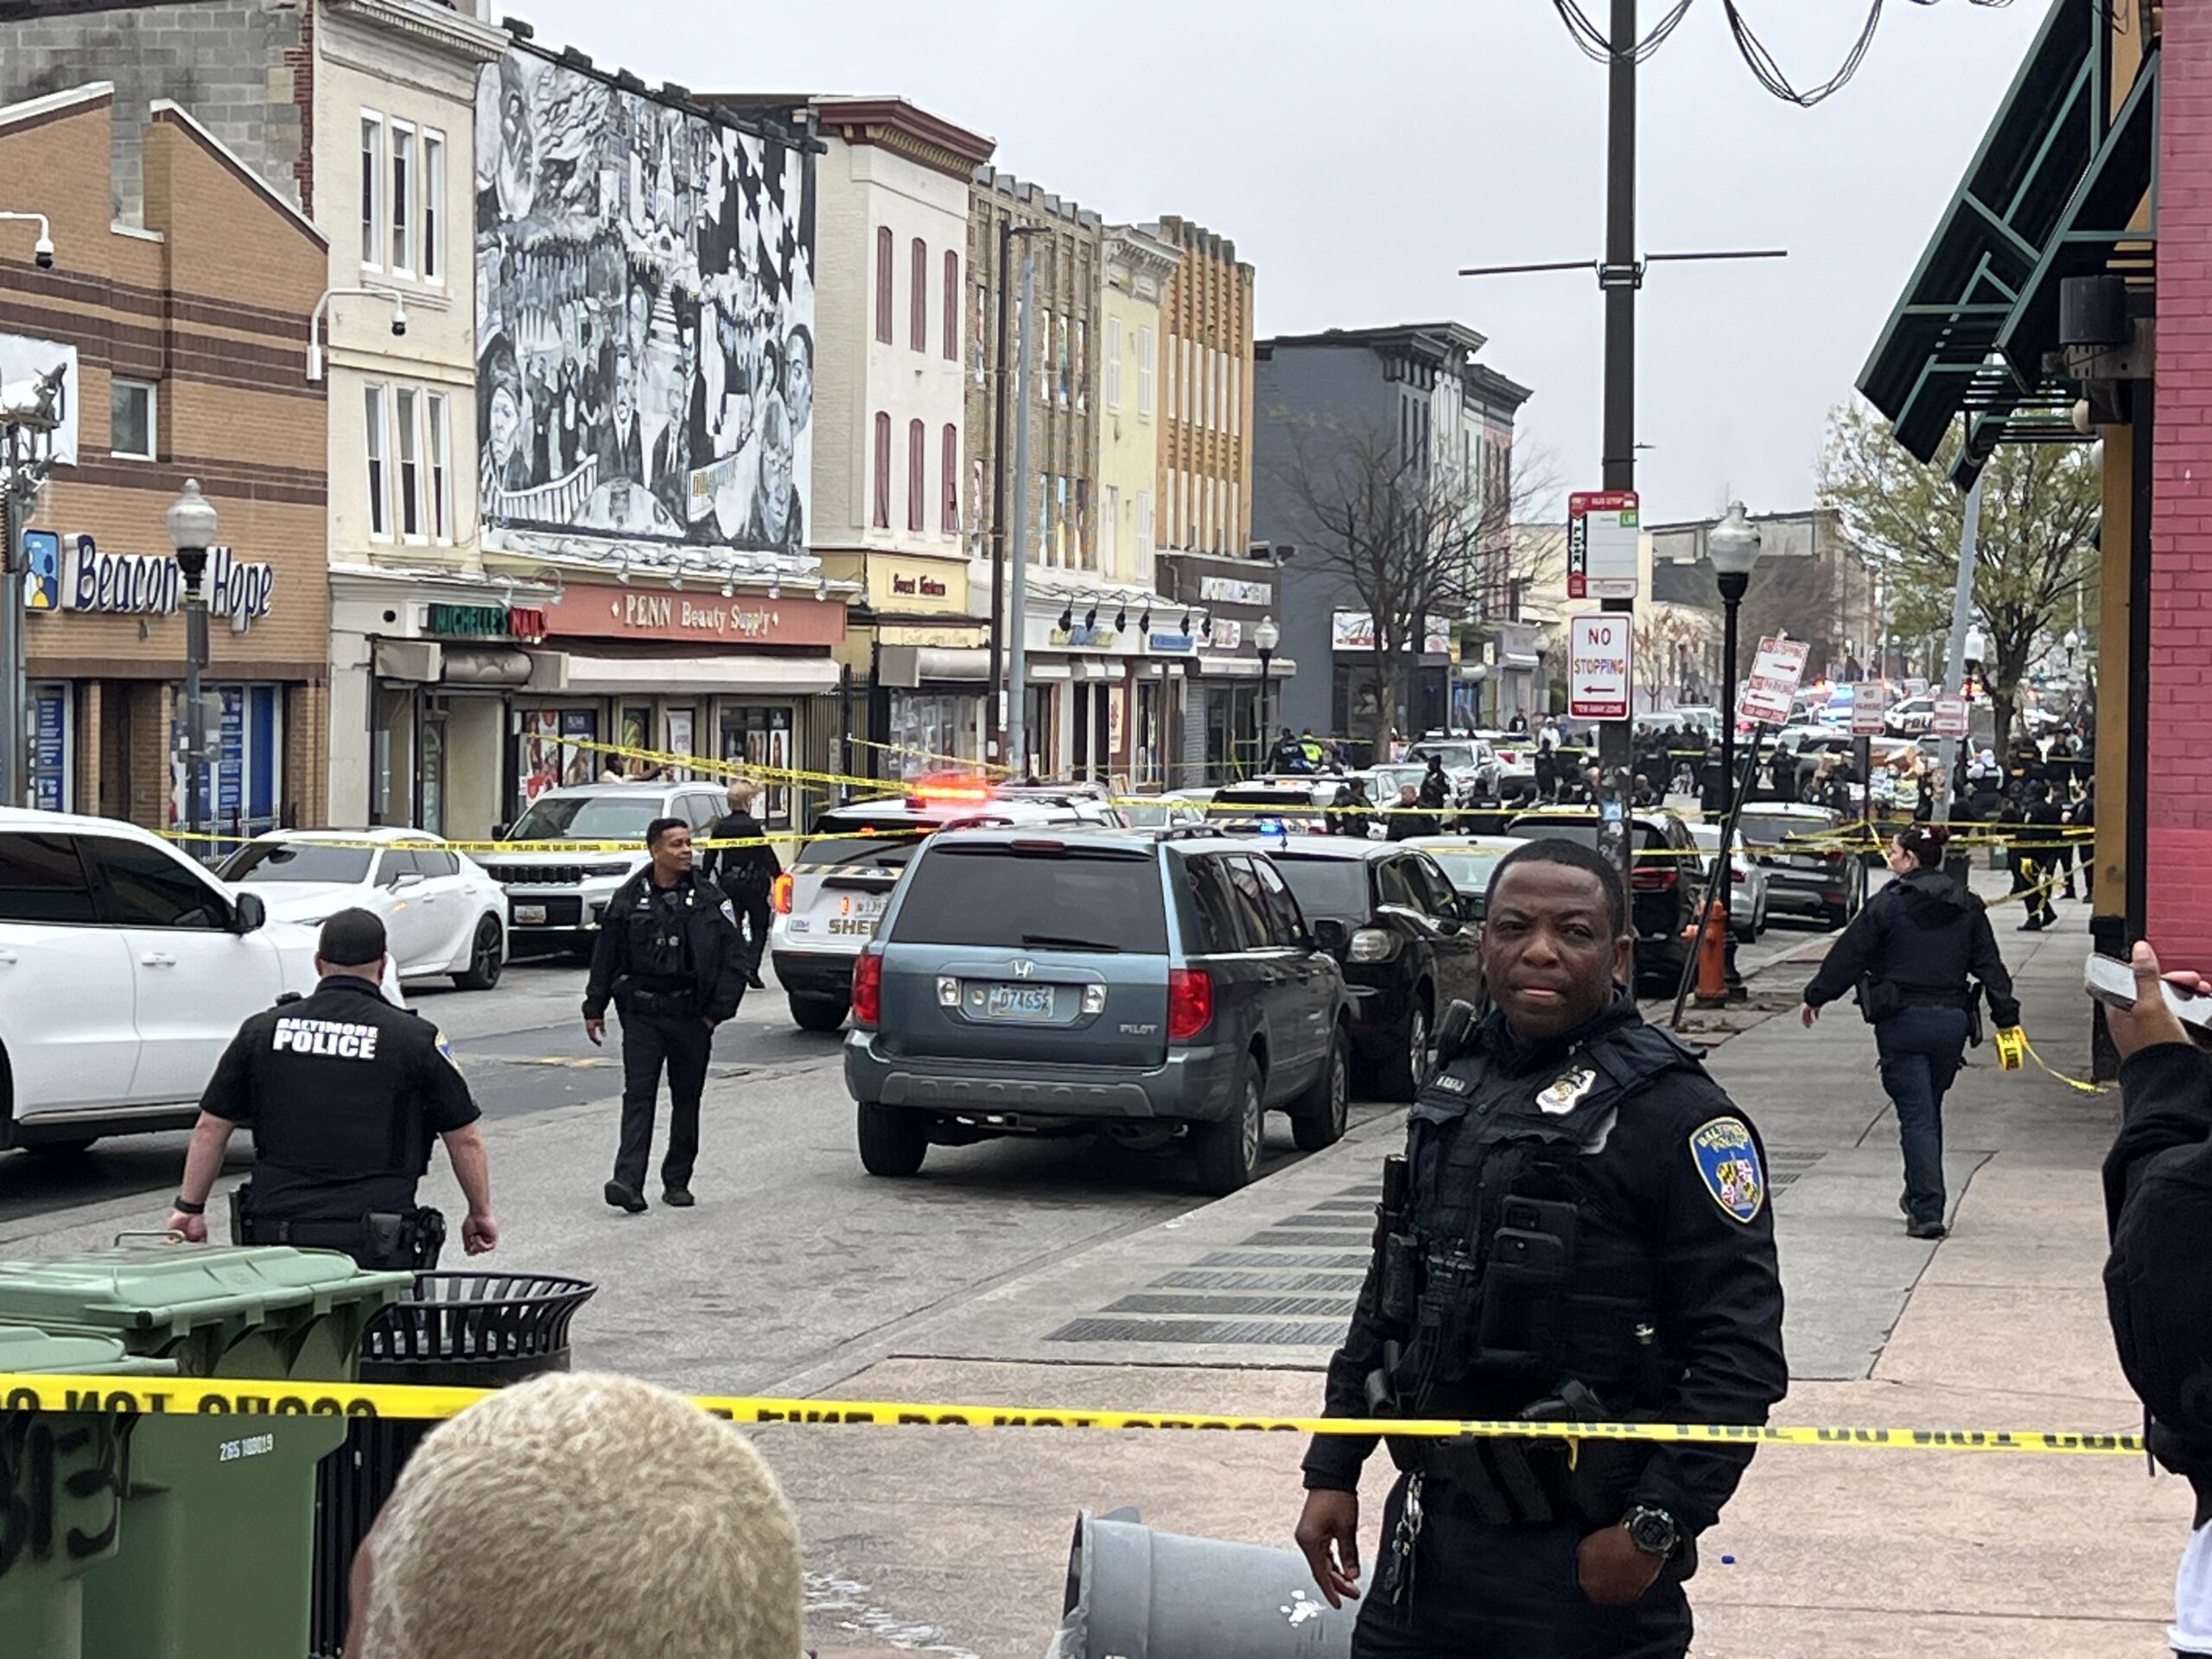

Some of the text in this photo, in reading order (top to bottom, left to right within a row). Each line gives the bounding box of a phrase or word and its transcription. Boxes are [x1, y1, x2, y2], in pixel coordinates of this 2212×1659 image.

[63, 533, 273, 632] Beacon Hope
[624, 594, 770, 636] PENN Beauty Supply
[1588, 627, 1611, 645] NO
[1573, 658, 1624, 676] STOPPING
[1120, 1024, 1159, 1035] PILOT
[272, 1028, 377, 1059] POLICE
